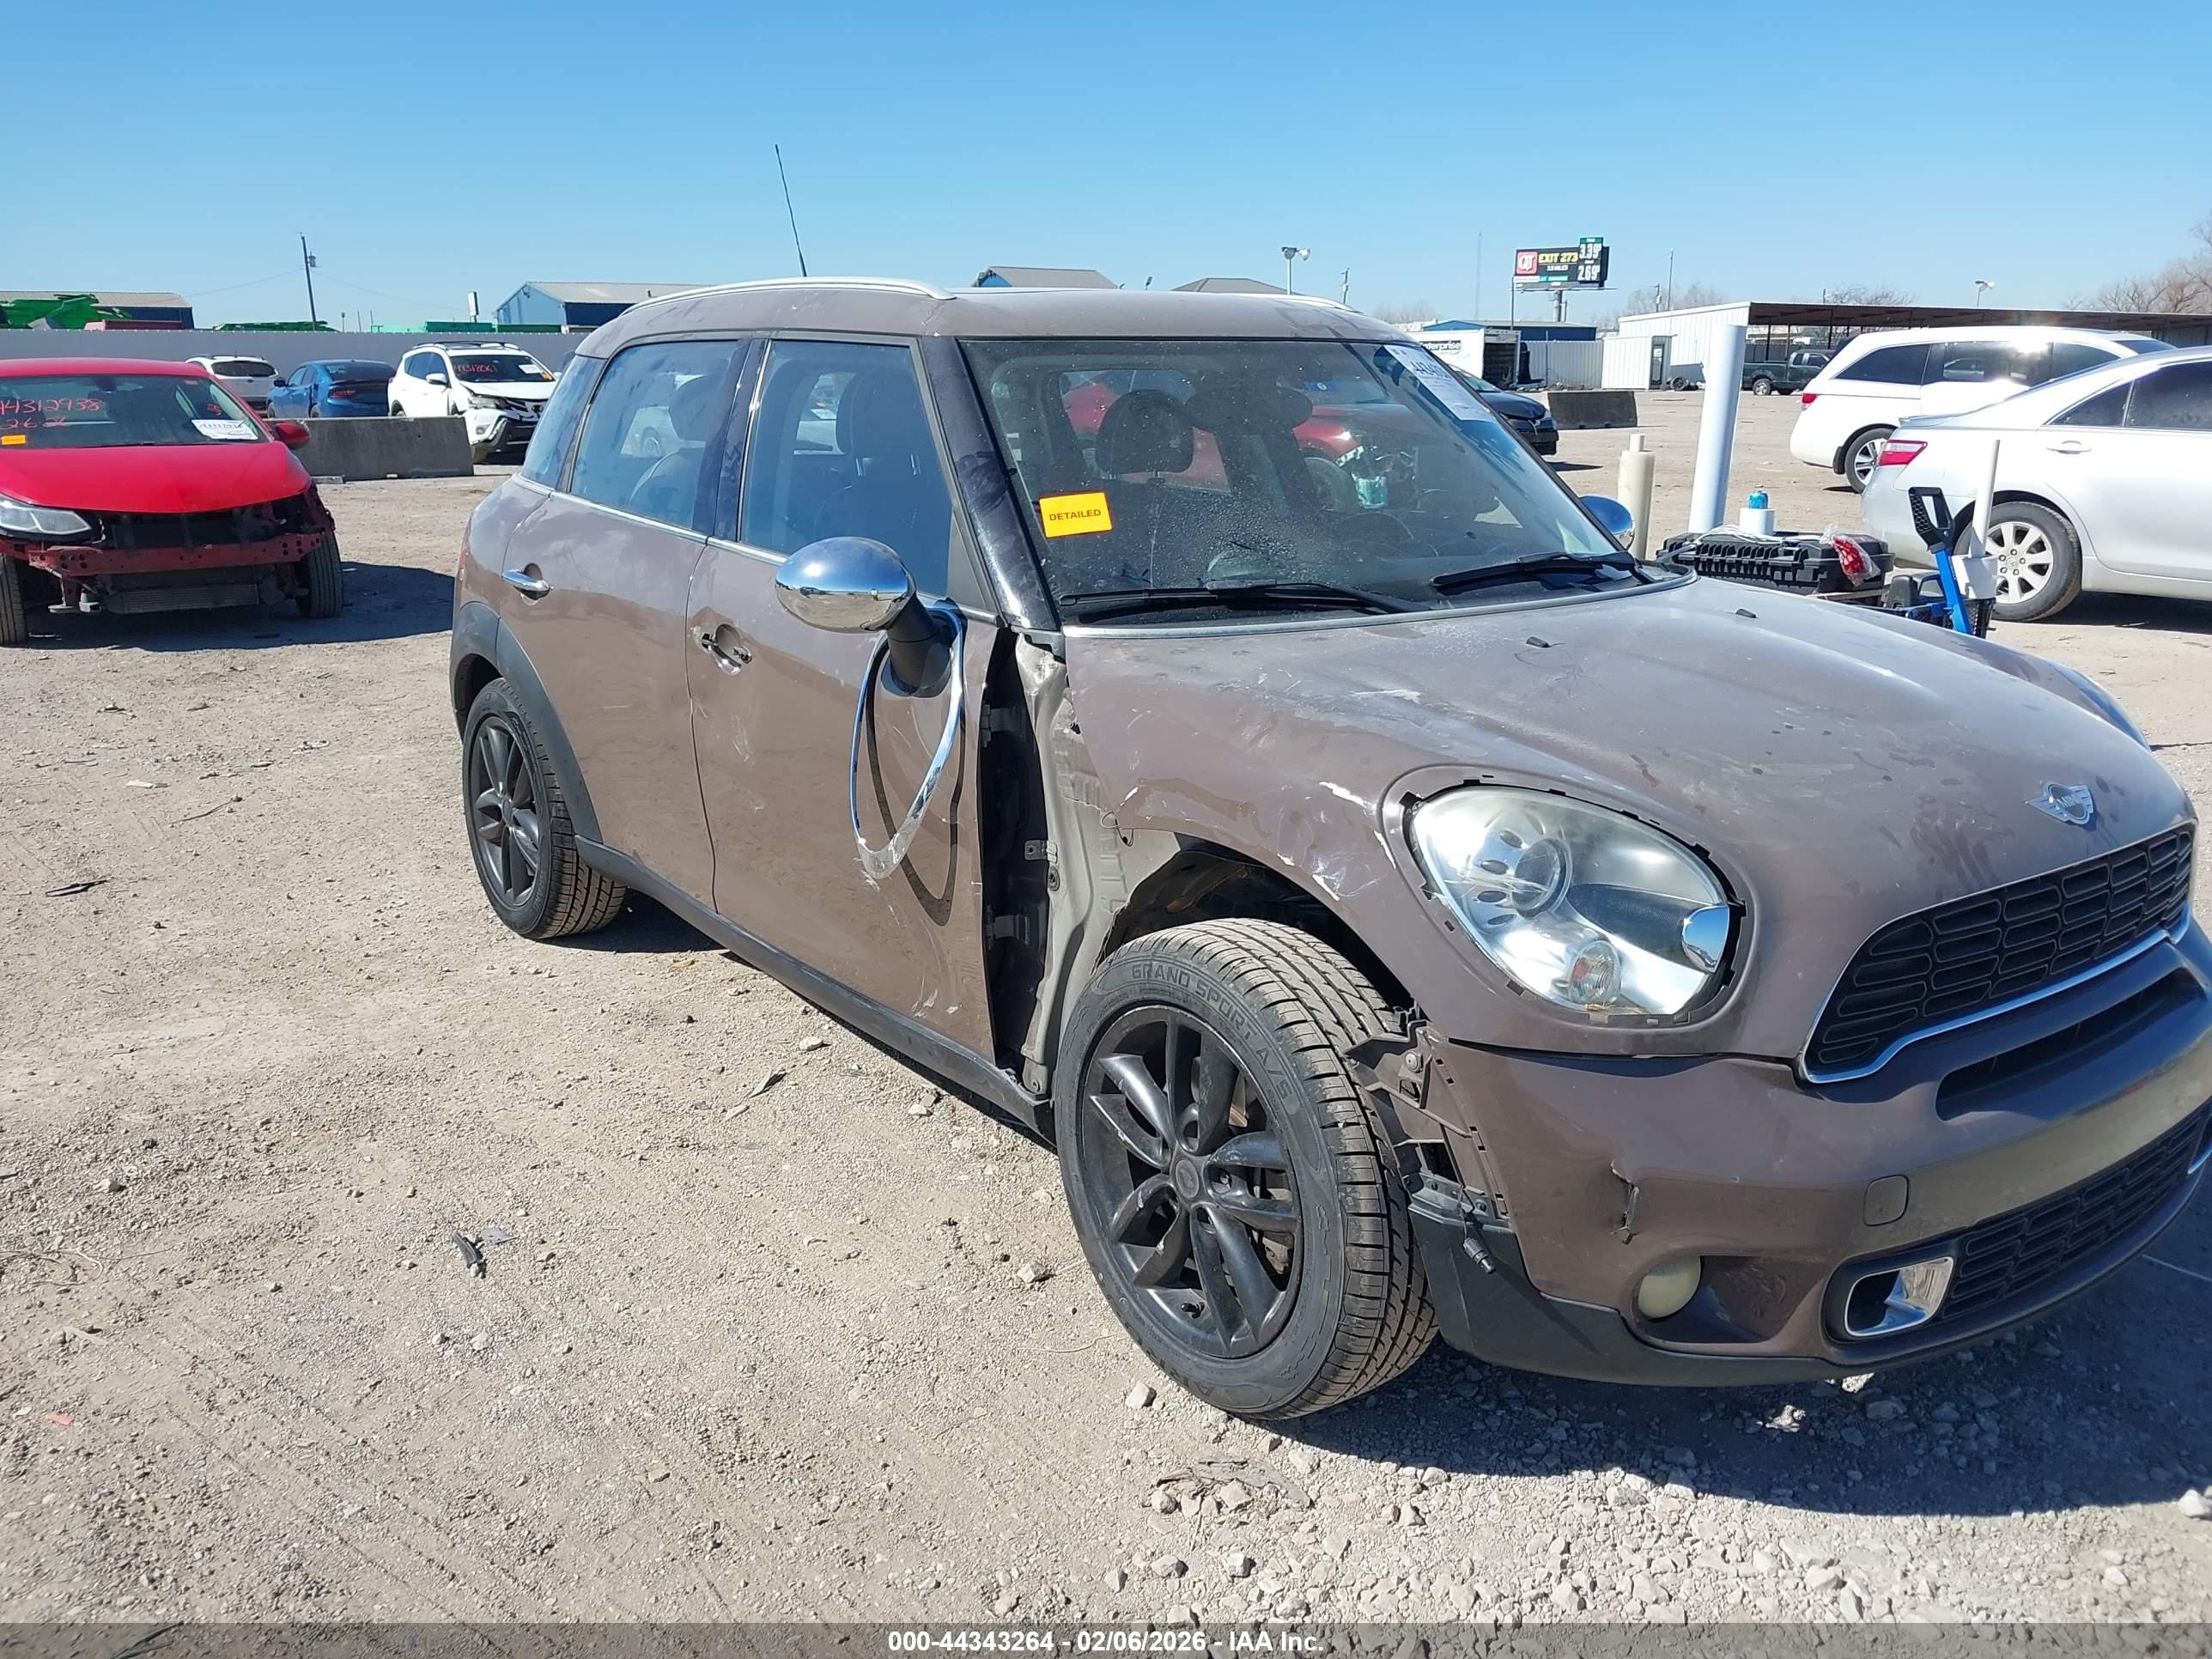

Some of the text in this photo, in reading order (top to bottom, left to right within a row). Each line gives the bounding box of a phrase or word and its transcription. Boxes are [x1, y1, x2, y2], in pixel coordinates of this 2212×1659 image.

[1538, 252, 1559, 263] EXIT
[1560, 252, 1578, 262] 273
[1049, 508, 1101, 520] DETAILED
[1132, 963, 1191, 988] GRAND
[1195, 979, 1258, 1040] SPORT
[1255, 1047, 1293, 1099] A/S
